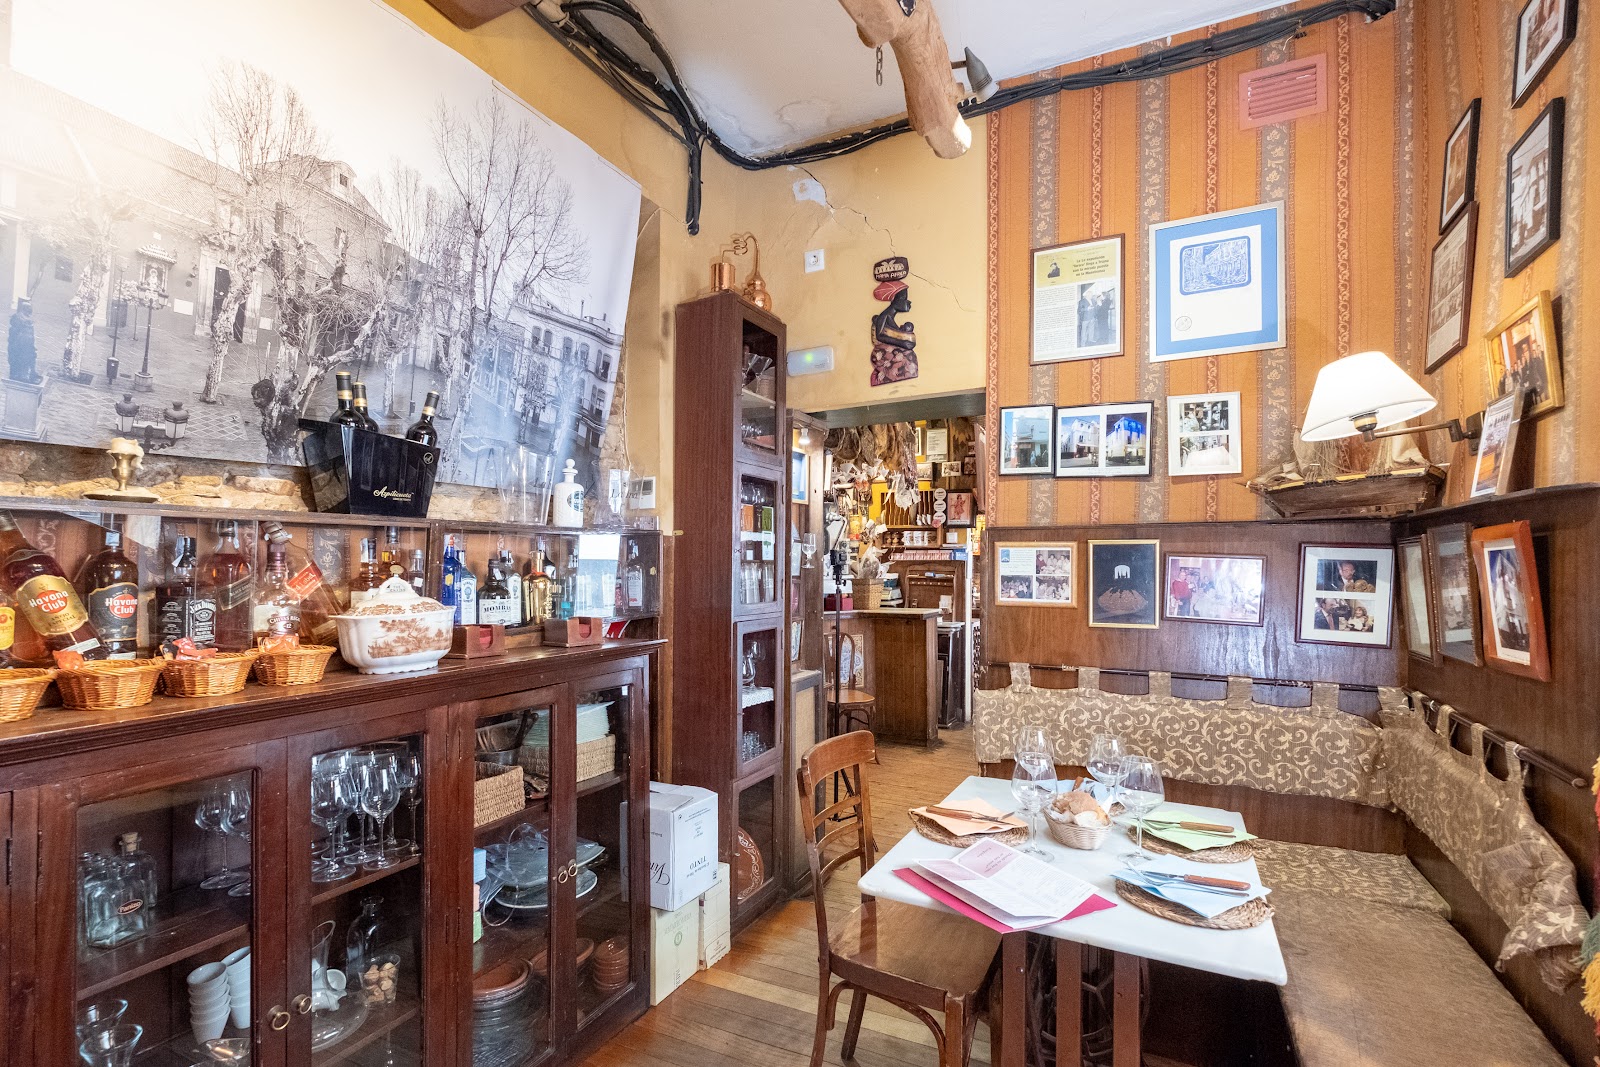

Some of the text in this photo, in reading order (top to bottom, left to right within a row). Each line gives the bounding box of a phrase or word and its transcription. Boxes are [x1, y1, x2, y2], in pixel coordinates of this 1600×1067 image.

[890, 270, 906, 278] AFRICA
[28, 590, 69, 608] Havana
[42, 600, 66, 612] Club
[114, 606, 134, 614] Club
[269, 616, 290, 624] CHIVAS
[689, 856, 706, 870] TINTO
